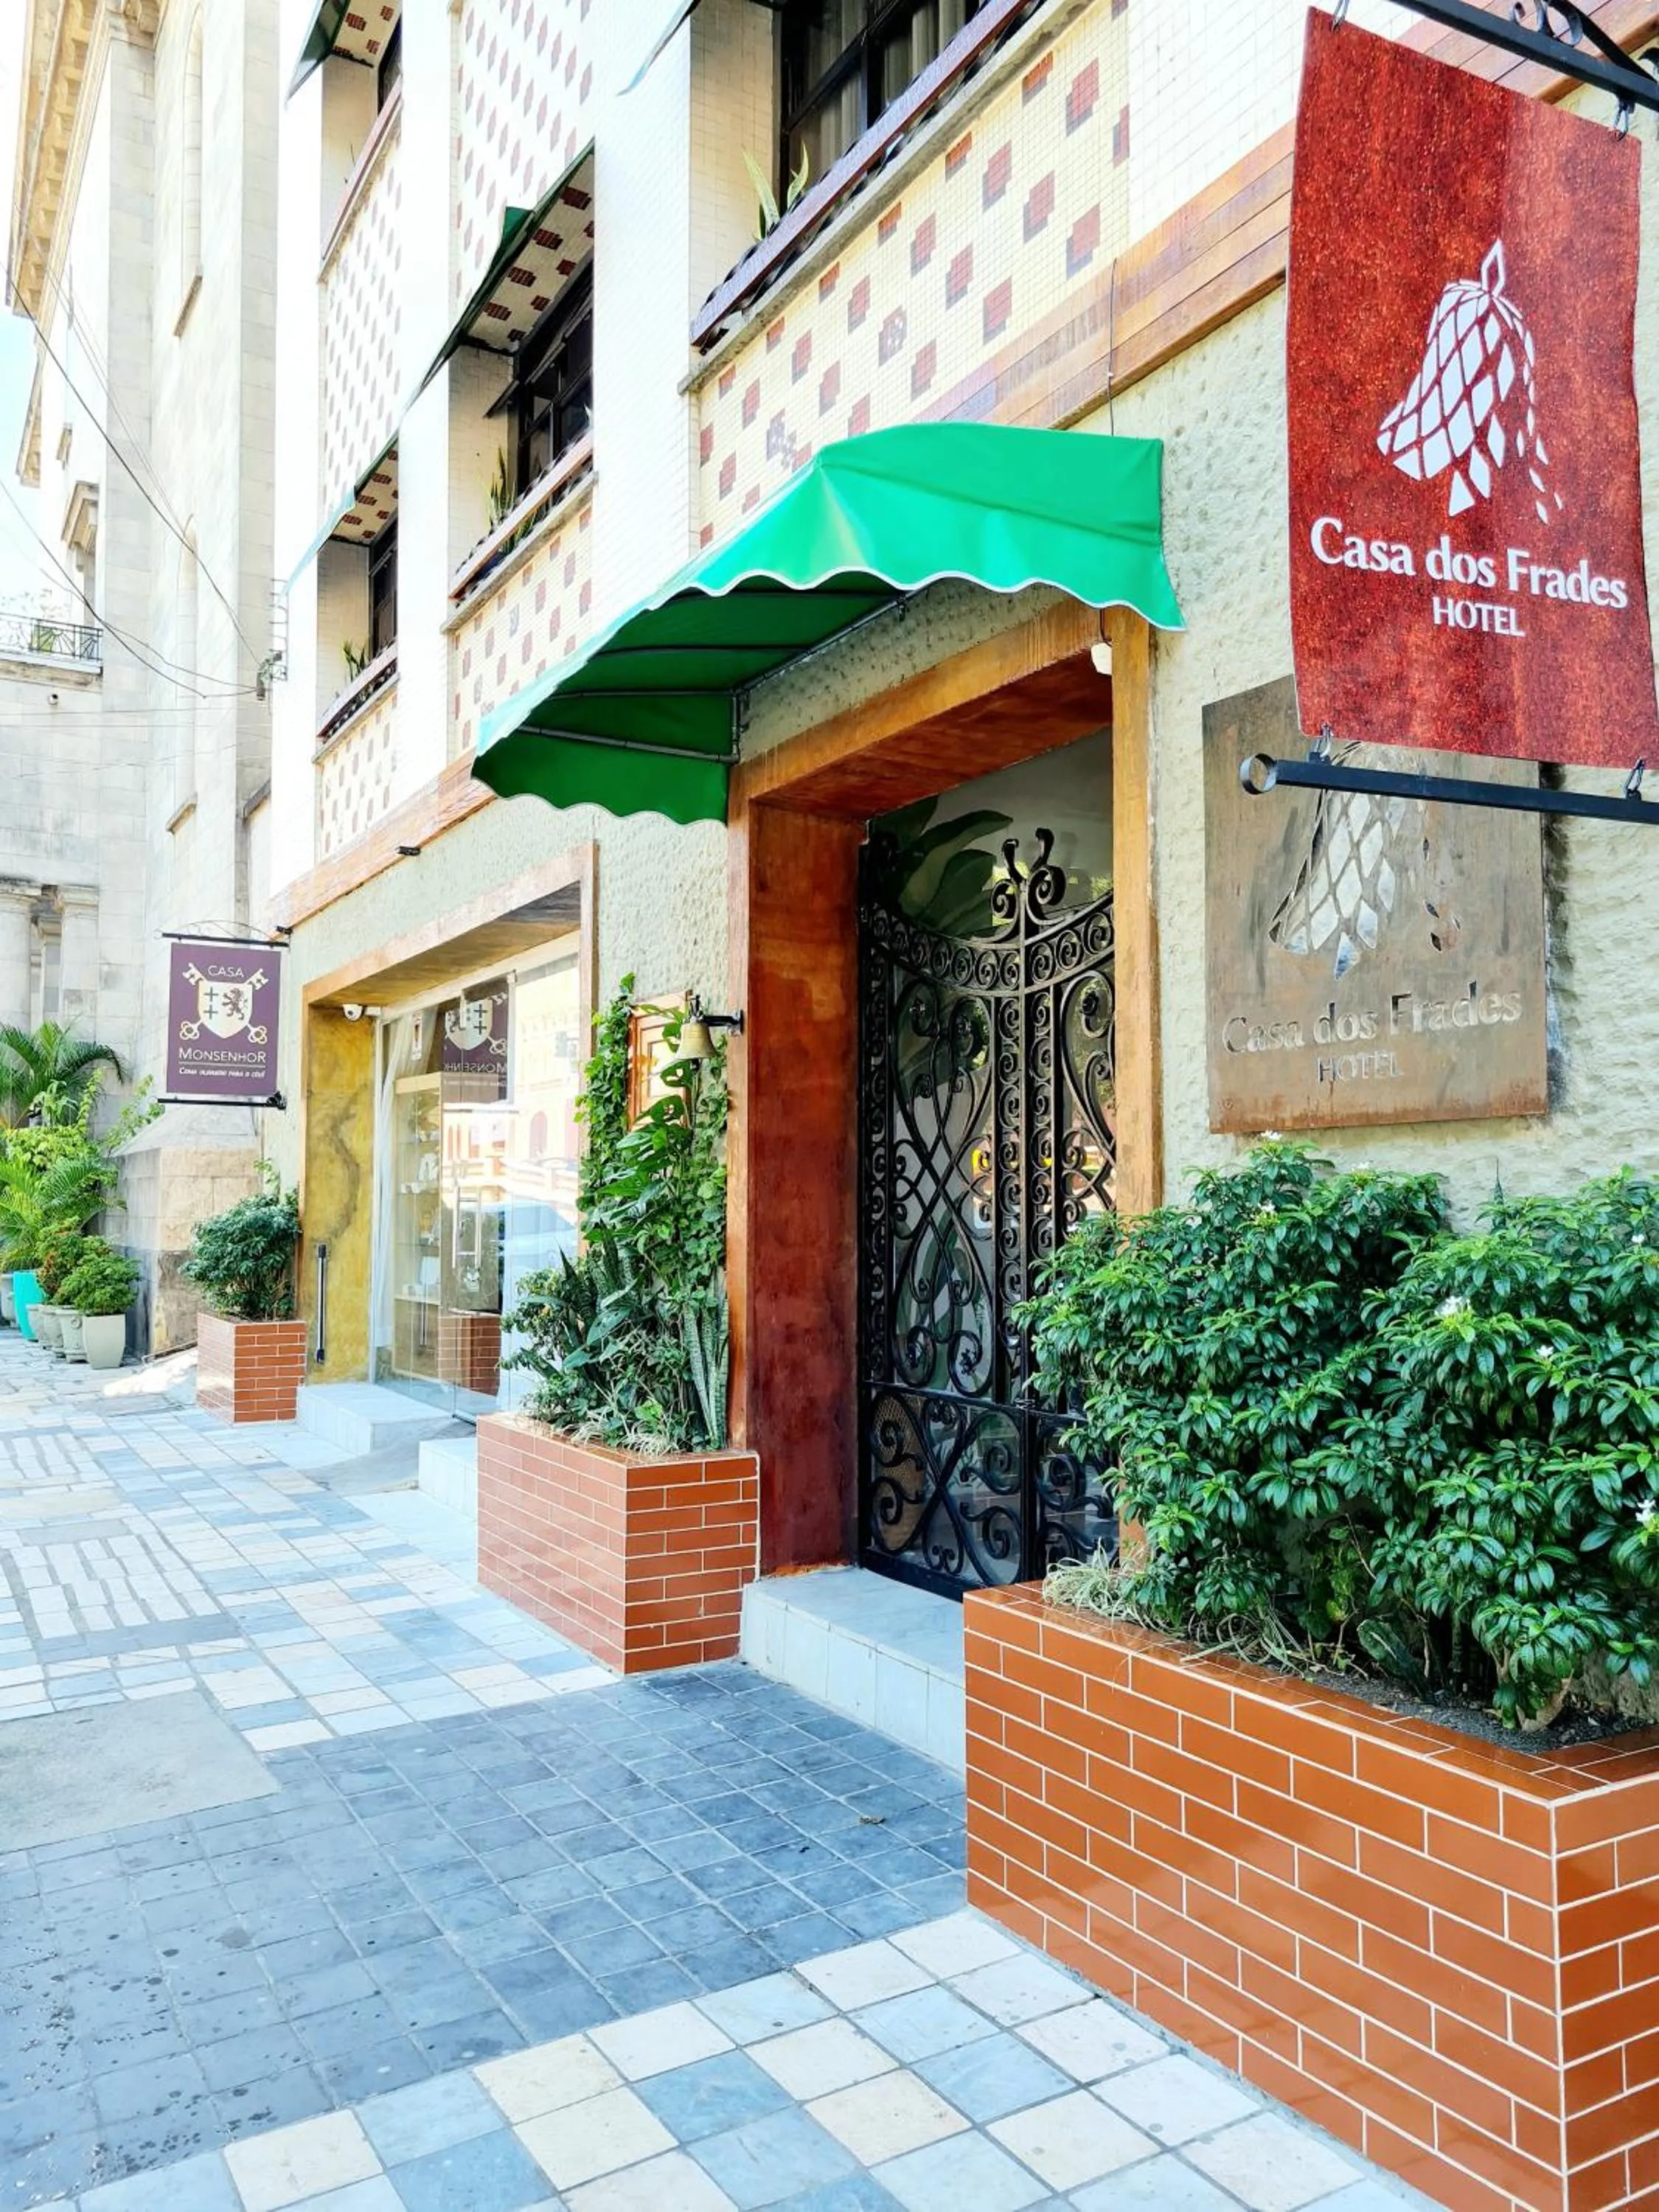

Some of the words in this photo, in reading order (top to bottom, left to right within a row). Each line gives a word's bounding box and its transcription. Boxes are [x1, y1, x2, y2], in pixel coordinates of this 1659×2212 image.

[1310, 516, 1416, 576] Casa
[1425, 535, 1497, 588] dos
[1506, 547, 1629, 609] Frades
[1433, 596, 1526, 638] HOTEL
[207, 965, 244, 978] CASA
[1222, 1015, 1305, 1055] Casa
[1313, 1001, 1379, 1045] dos
[1390, 980, 1522, 1034] Frades
[178, 1047, 266, 1063] MONSENHOR
[1318, 1049, 1404, 1082] HOTEL
